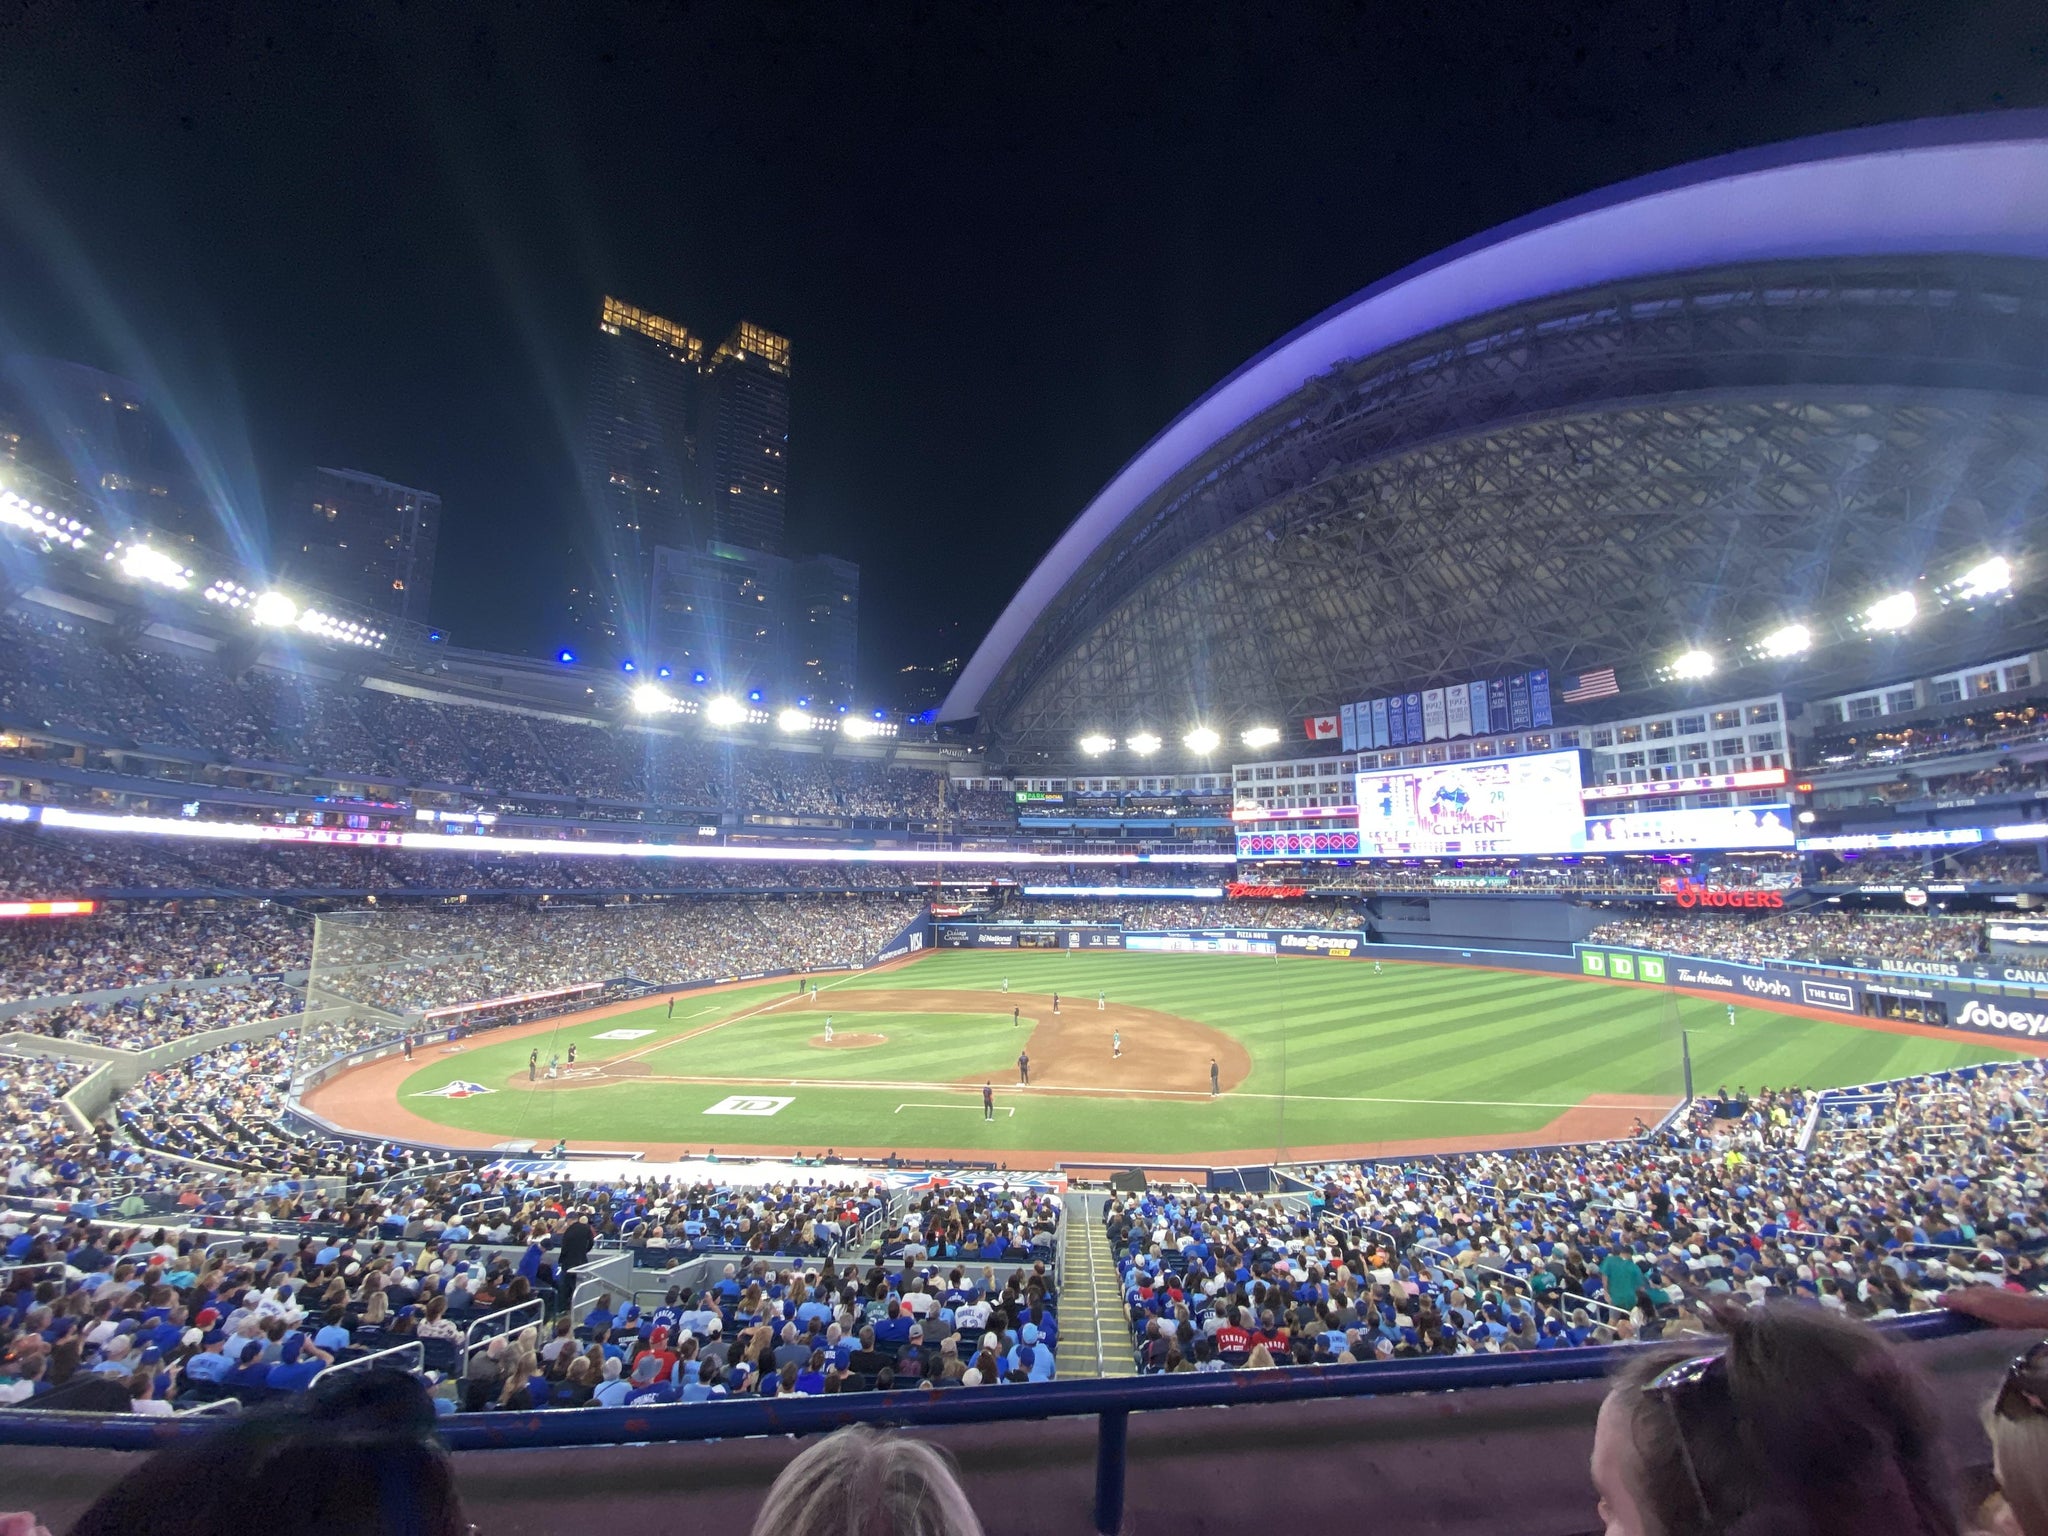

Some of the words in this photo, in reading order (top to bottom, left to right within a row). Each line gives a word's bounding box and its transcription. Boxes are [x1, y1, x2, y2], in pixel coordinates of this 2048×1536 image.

[1433, 821, 1506, 836] CLEMENT
[1226, 883, 1305, 898] Budweiser
[1701, 890, 1783, 908] ROGERS
[909, 932, 923, 952] VISA
[987, 934, 1012, 942] National
[1236, 930, 1252, 939] PIZZA
[1253, 931, 1269, 940] NOVA
[1281, 934, 1358, 949] theScore
[1584, 955, 1604, 971] TD
[1609, 957, 1632, 975] TD
[1641, 960, 1663, 978] TD
[1881, 959, 1959, 977] BLEACHERS
[1677, 968, 1696, 983] Tim
[1696, 970, 1733, 987] Hortons
[2004, 968, 2048, 984] CANA
[1742, 974, 1791, 998] Kubota
[1808, 988, 1827, 1000] THE
[1828, 991, 1847, 1002] KEG
[729, 1099, 779, 1111] TD
[1221, 1334, 1247, 1346] CANADA
[1264, 1340, 1285, 1350] ANADA
